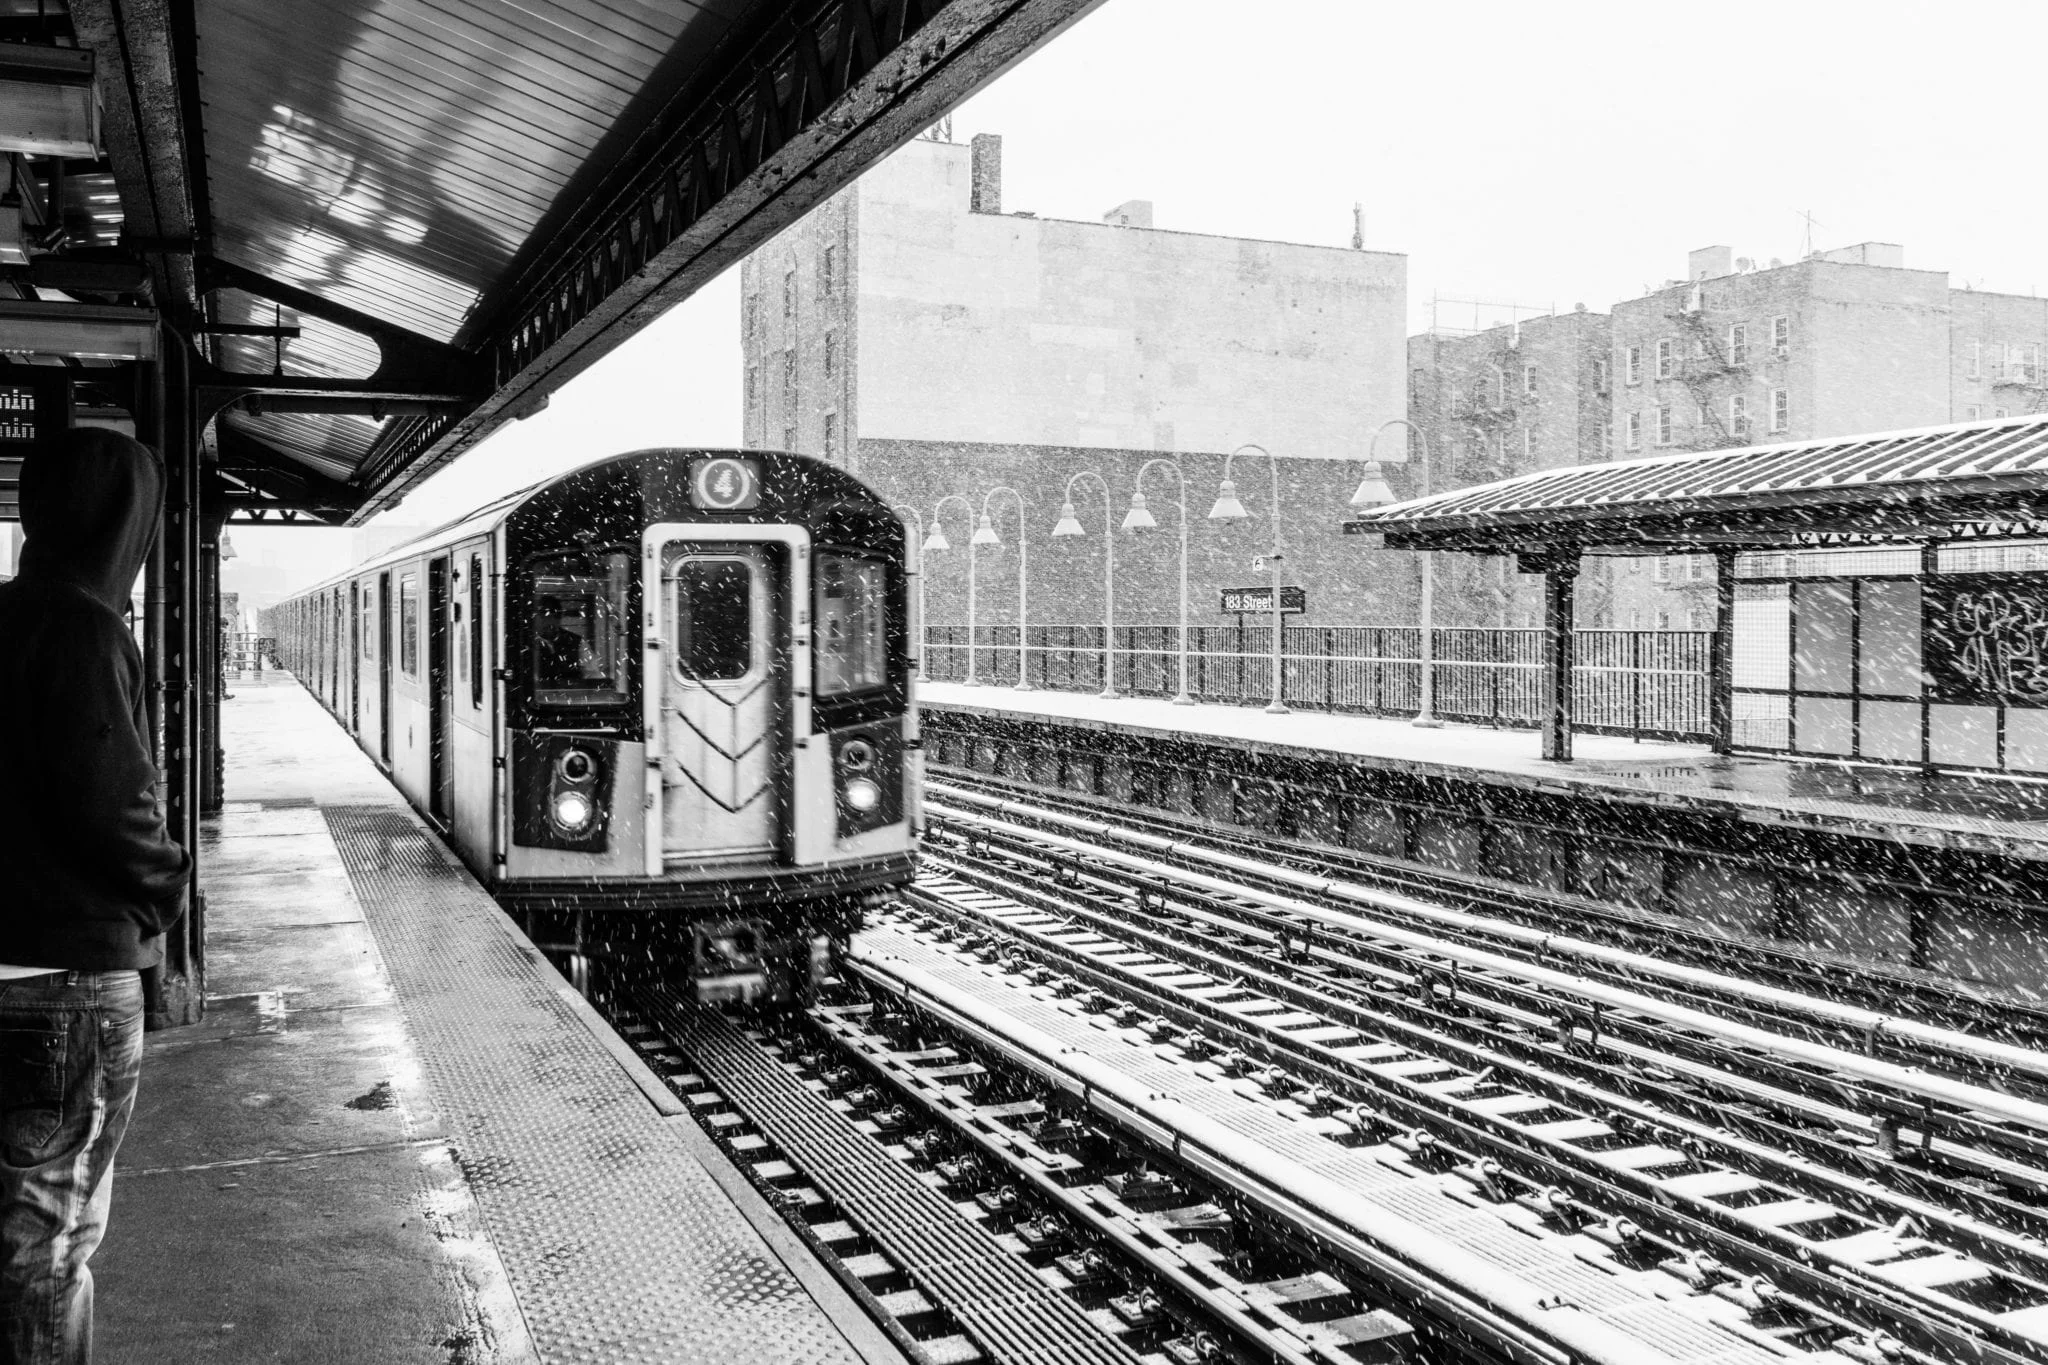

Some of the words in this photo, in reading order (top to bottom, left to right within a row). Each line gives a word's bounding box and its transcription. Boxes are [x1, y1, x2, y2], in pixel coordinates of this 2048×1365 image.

[713, 468, 734, 498] 4
[1224, 595, 1241, 609] 183
[1243, 595, 1273, 609] Street
